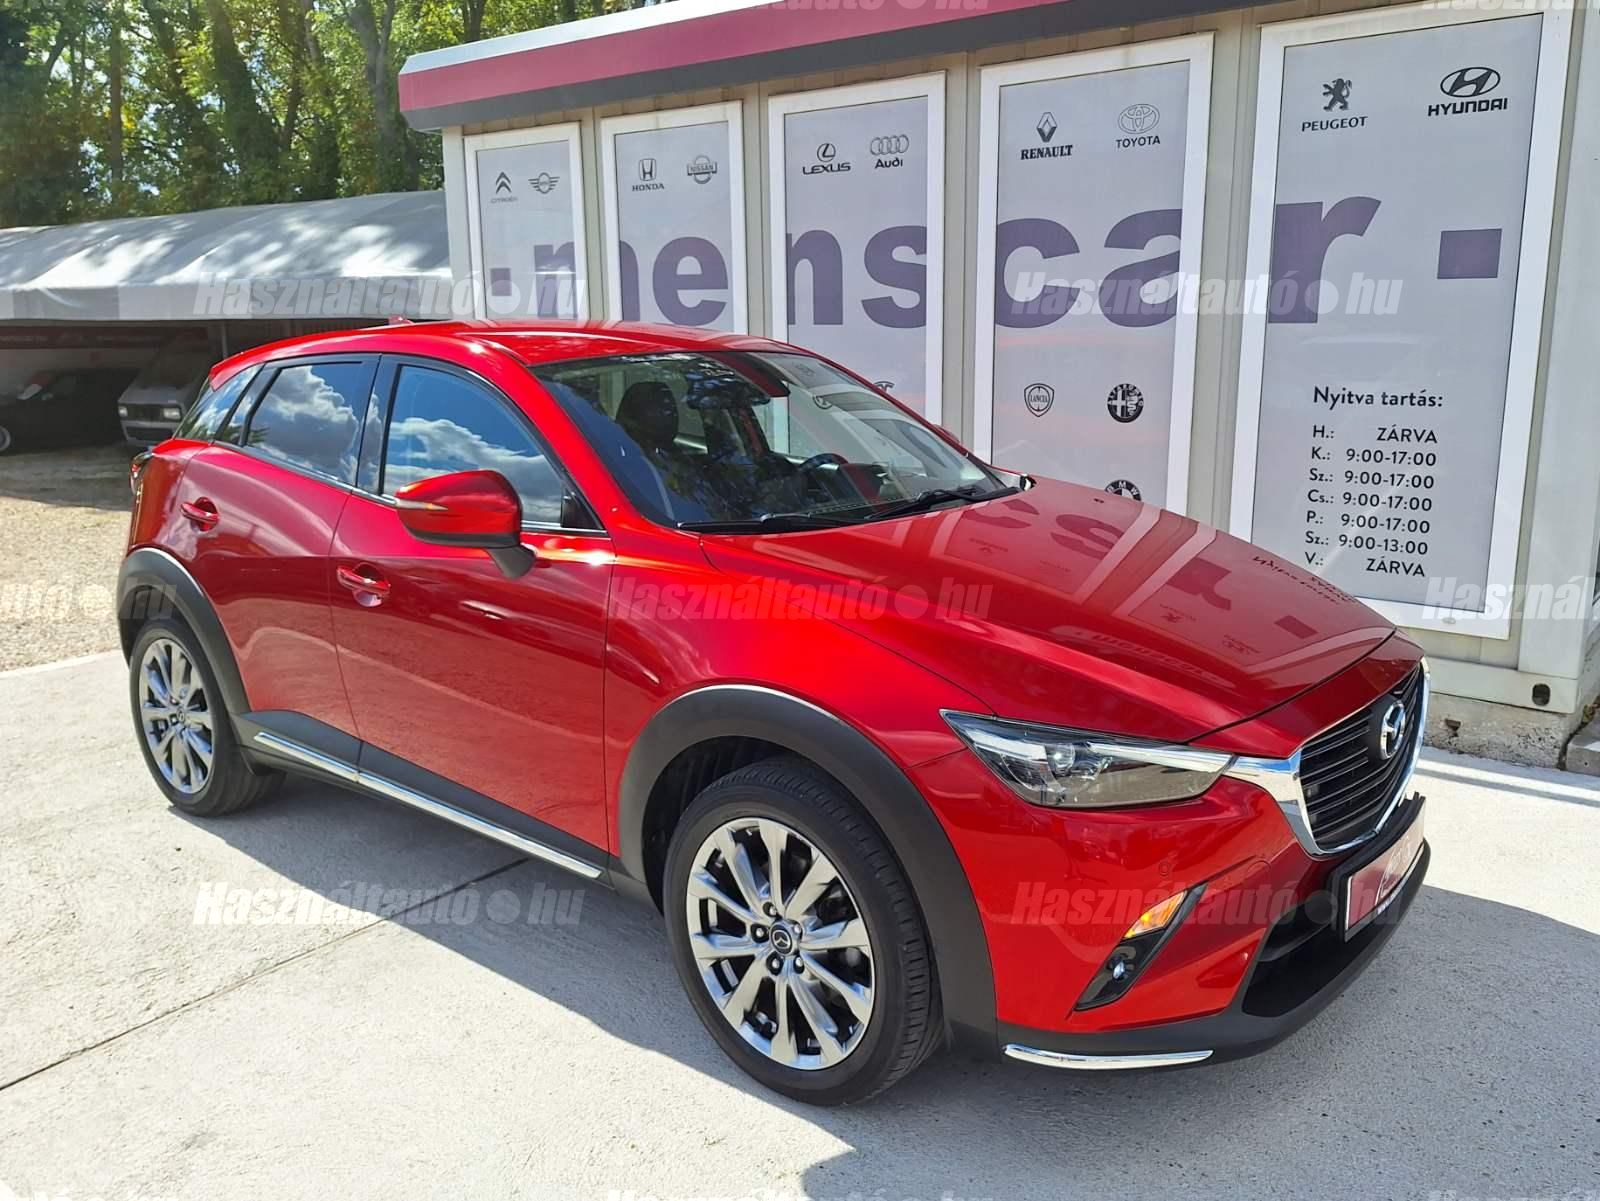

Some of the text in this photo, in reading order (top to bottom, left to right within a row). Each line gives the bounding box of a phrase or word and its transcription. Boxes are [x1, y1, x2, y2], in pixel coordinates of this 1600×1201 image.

[1427, 98, 1508, 117] HYUNDAI
[1301, 116, 1369, 132] PEUGEOT
[1115, 135, 1161, 149] TOYOTA
[1020, 145, 1073, 160] RENAULT
[689, 163, 715, 173] NISSAN
[802, 162, 852, 175] LEXUS
[874, 157, 904, 169] Audi
[631, 183, 665, 192] HONDA
[1313, 386, 1443, 411] Nyitva tartás:
[1312, 424, 1438, 443] H.: ZÁRVA
[1311, 446, 1437, 467] K.: 9:00-17:00
[1309, 468, 1435, 489] Sz.: 9:00-17:00
[1307, 489, 1433, 511] Cs.: 9:00-17:00
[1306, 510, 1431, 533] P.: 9:00-17:00
[1305, 530, 1428, 555] Sz.: 9:00-13:00
[1304, 552, 1426, 577] V.: ZÁRVA
